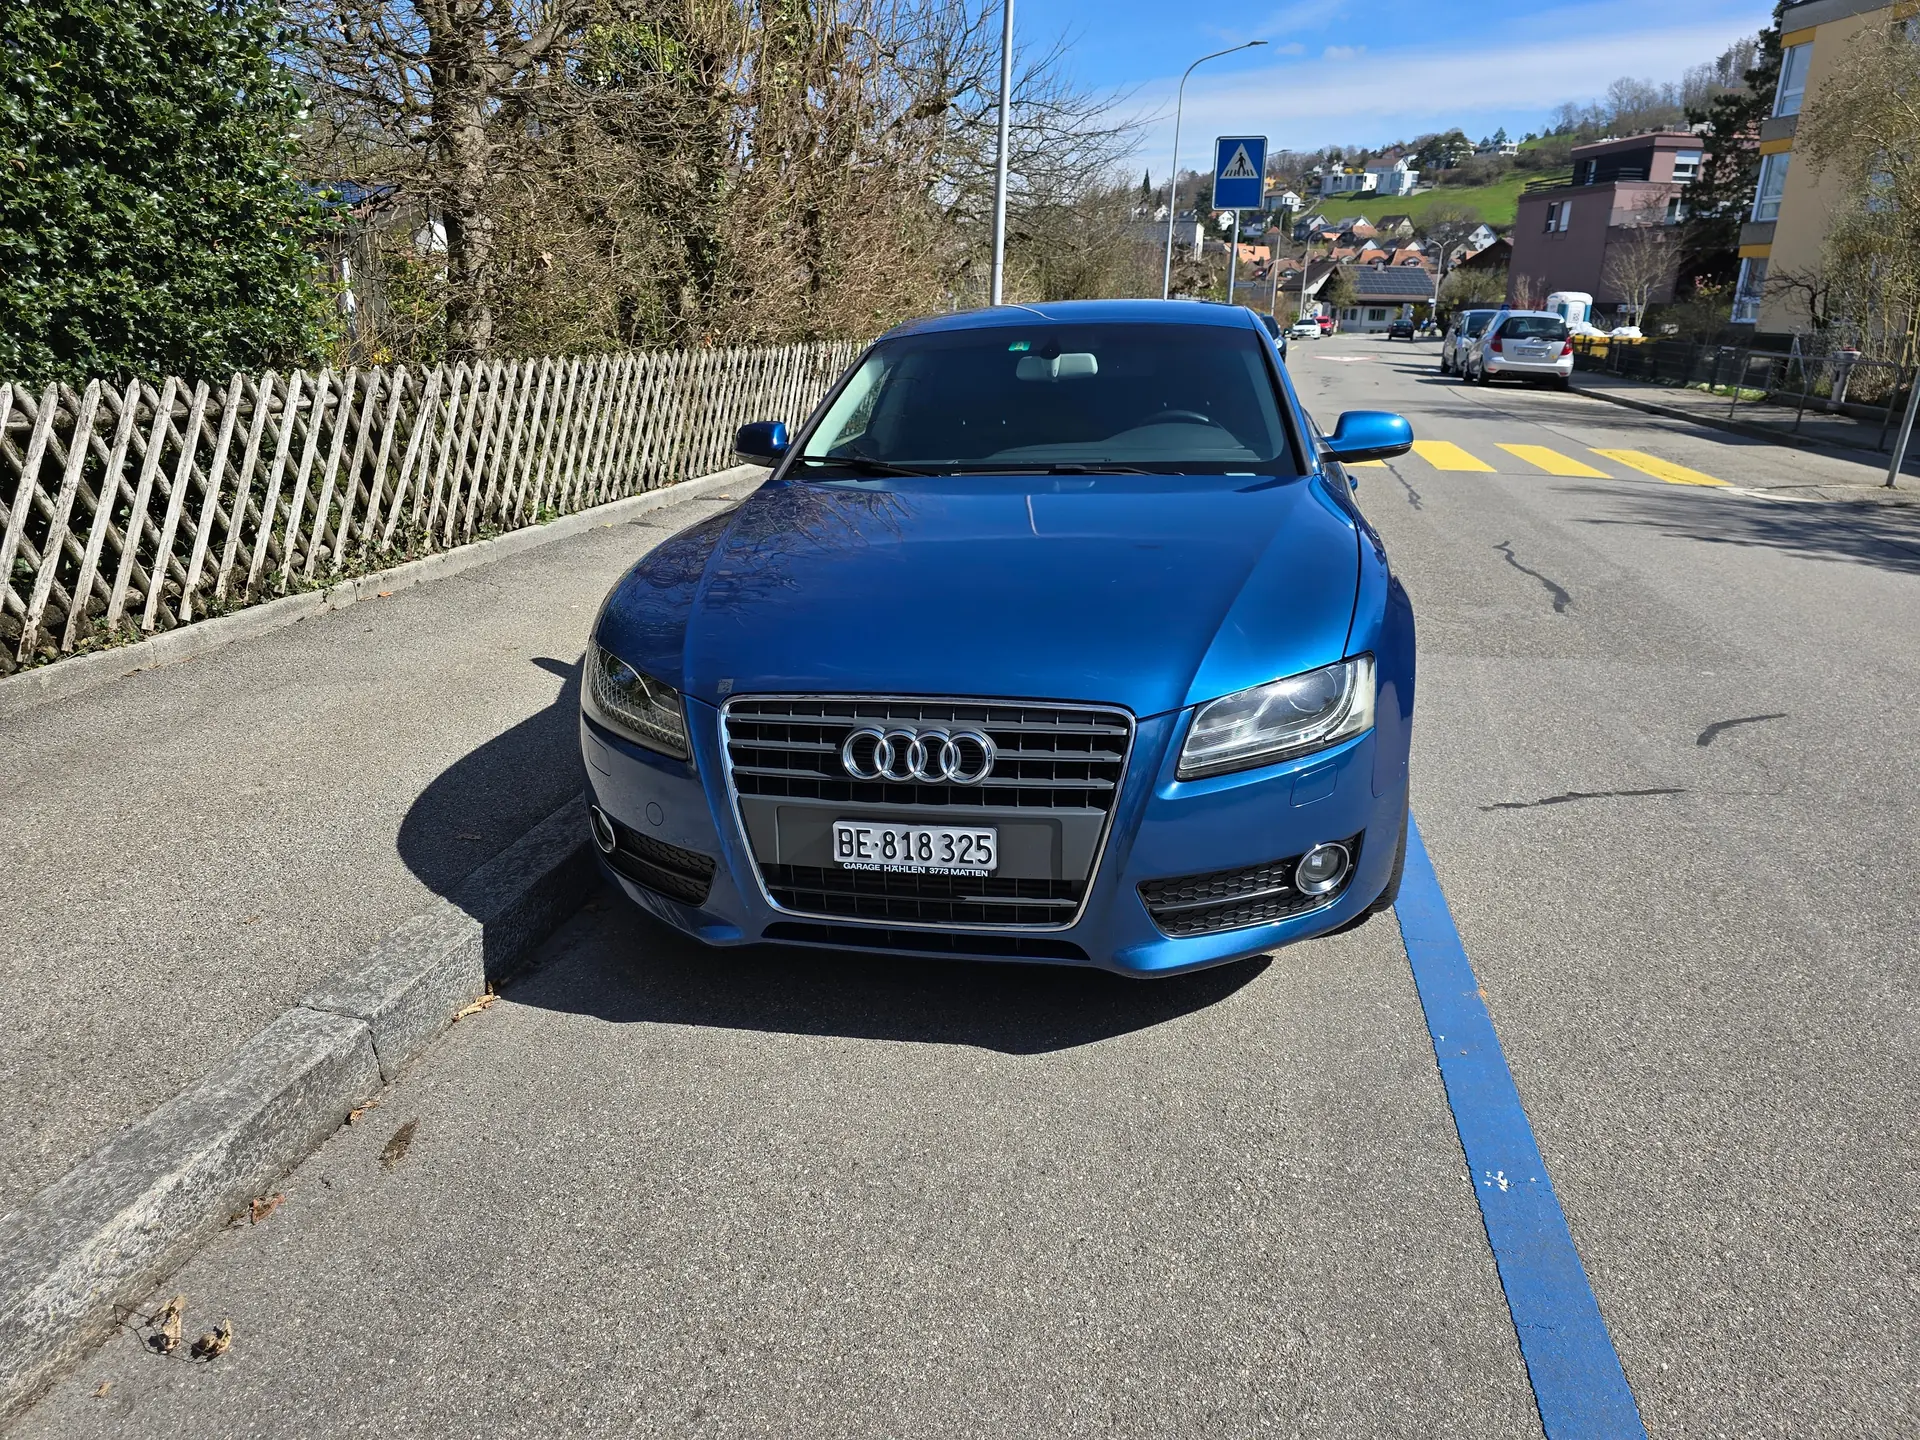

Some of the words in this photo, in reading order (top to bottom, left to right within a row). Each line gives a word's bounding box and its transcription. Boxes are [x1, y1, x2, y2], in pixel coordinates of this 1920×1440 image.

[940, 833, 992, 865] 325
[843, 862, 881, 871] GARAGE
[883, 864, 926, 874] HÄHLEN
[929, 867, 949, 875] 3773
[950, 868, 989, 877] MATTEN
